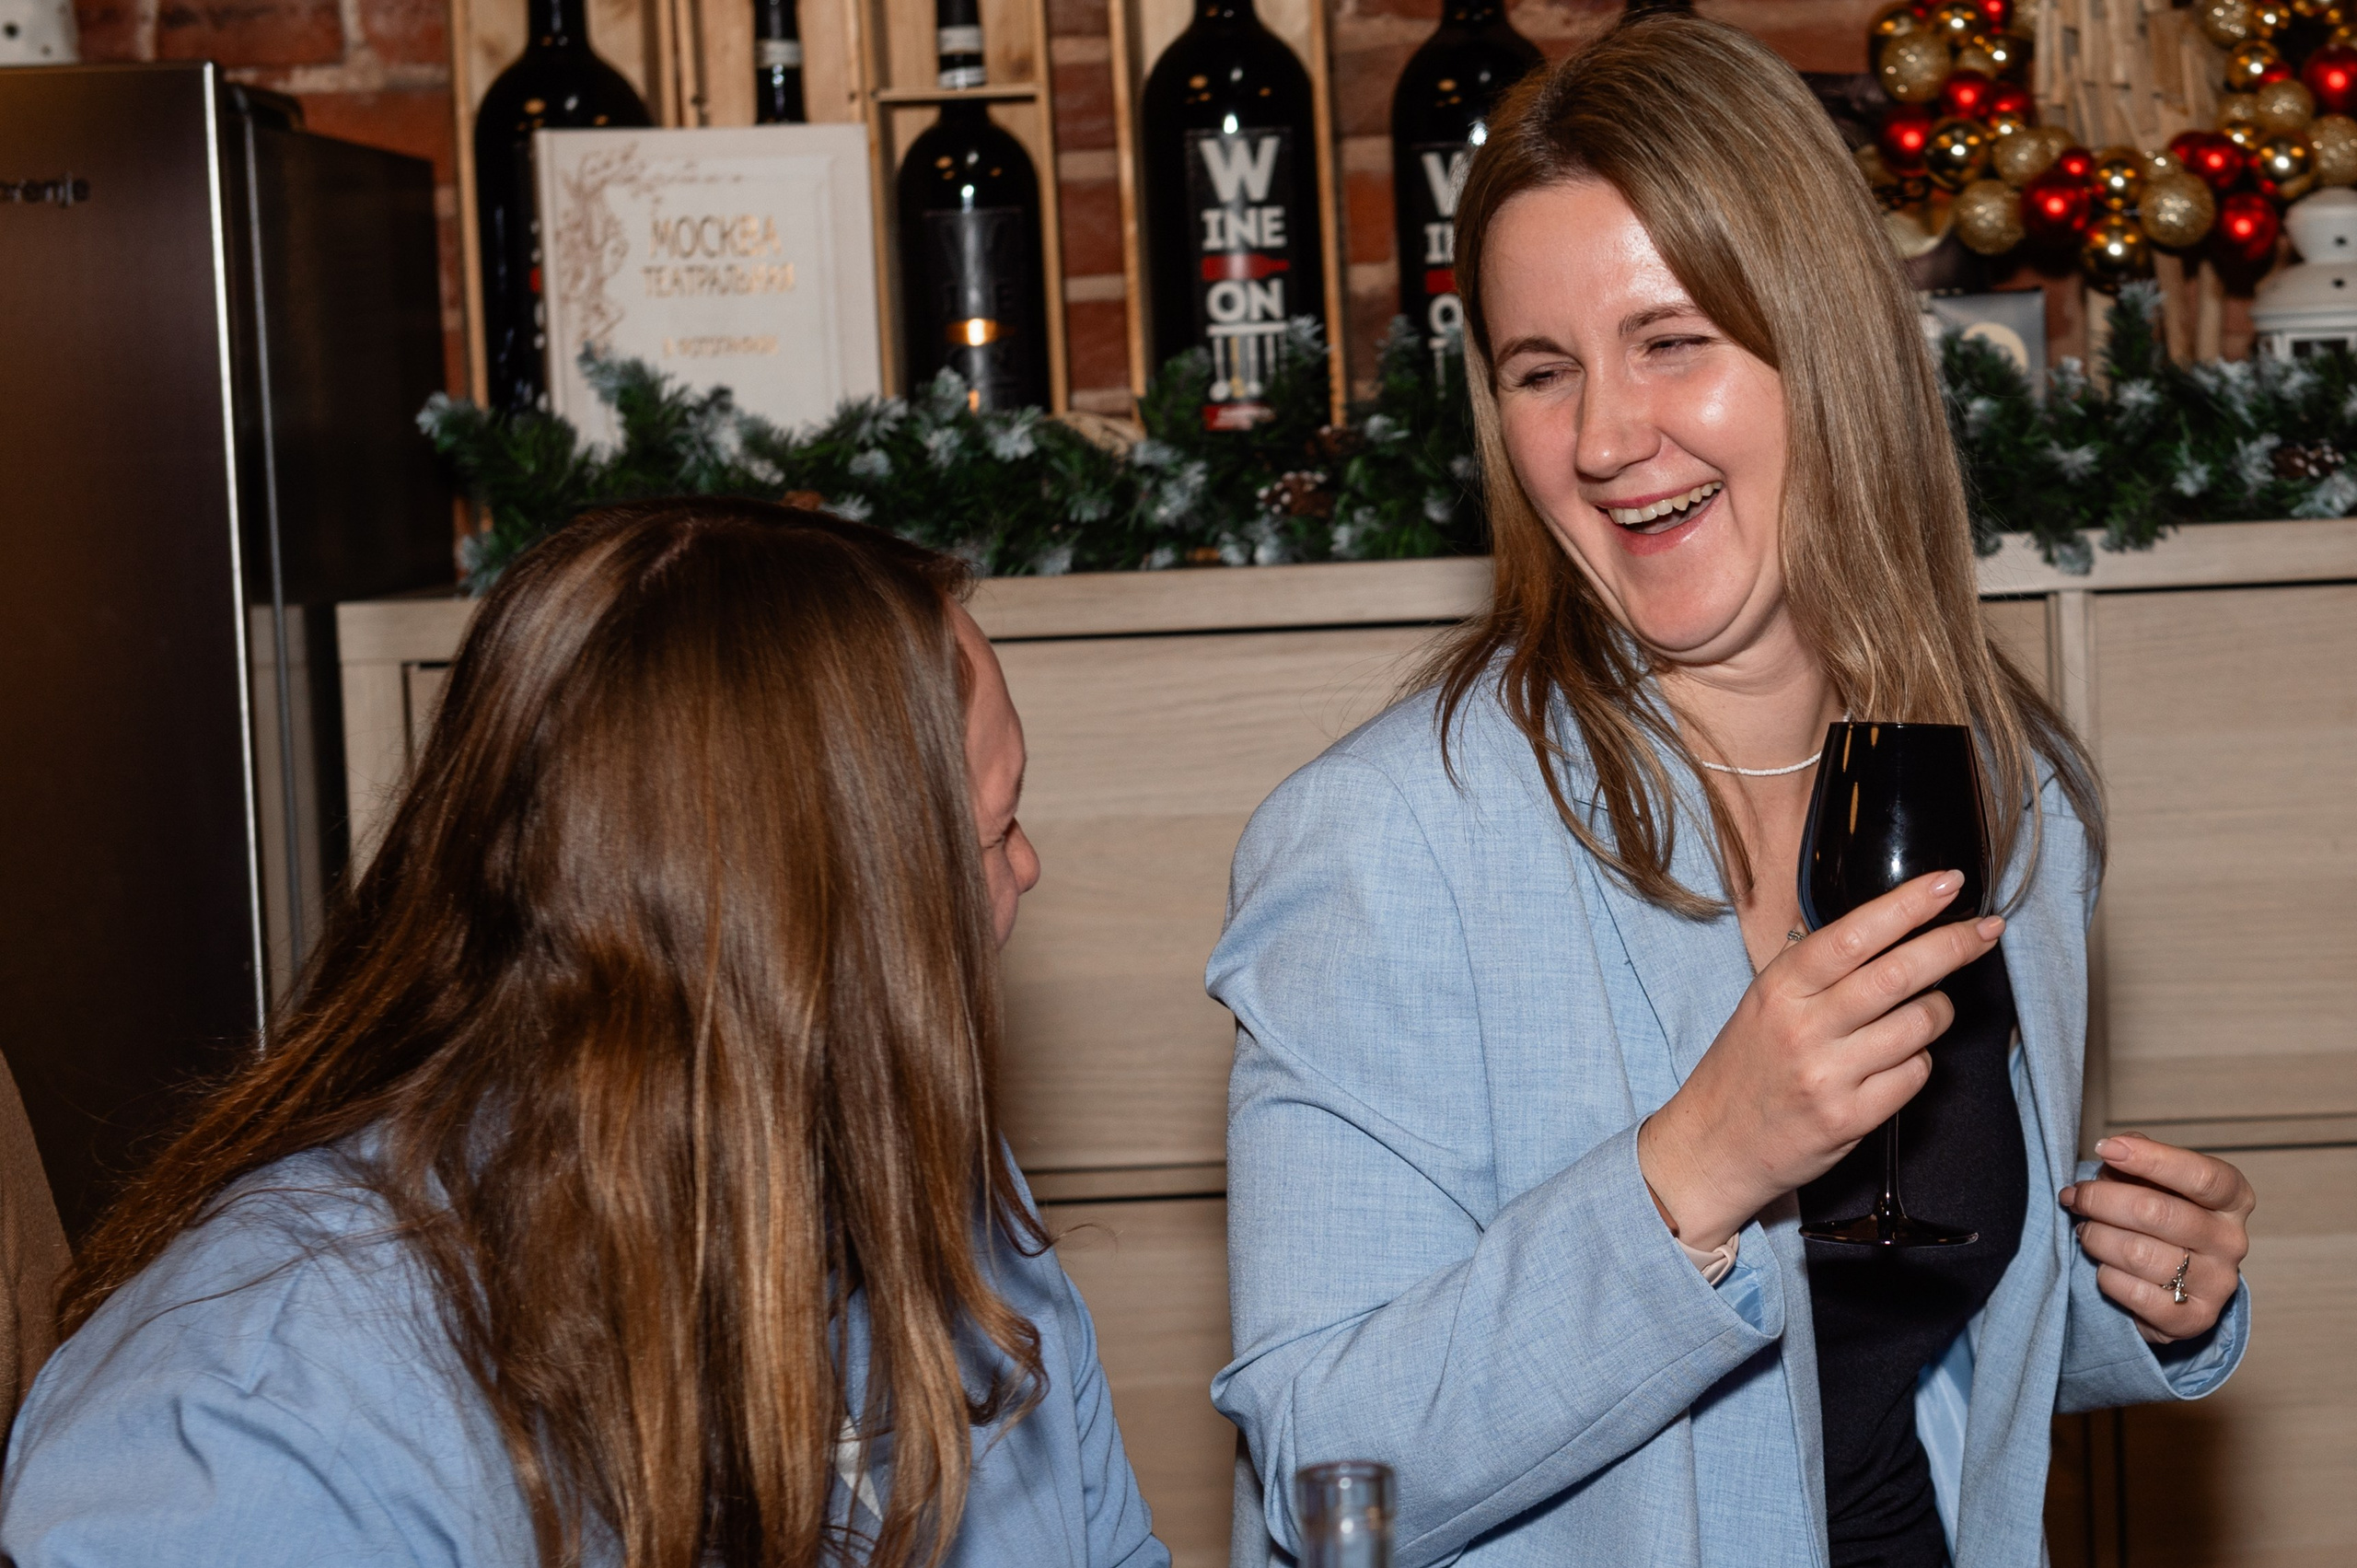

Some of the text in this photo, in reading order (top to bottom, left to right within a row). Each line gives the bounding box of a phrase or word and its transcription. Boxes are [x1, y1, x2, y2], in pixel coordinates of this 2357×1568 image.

[1200, 136, 1280, 203] W
[648, 215, 784, 259] МОСКВА
[1202, 205, 1287, 250] INE
[1207, 277, 1284, 322] ON
